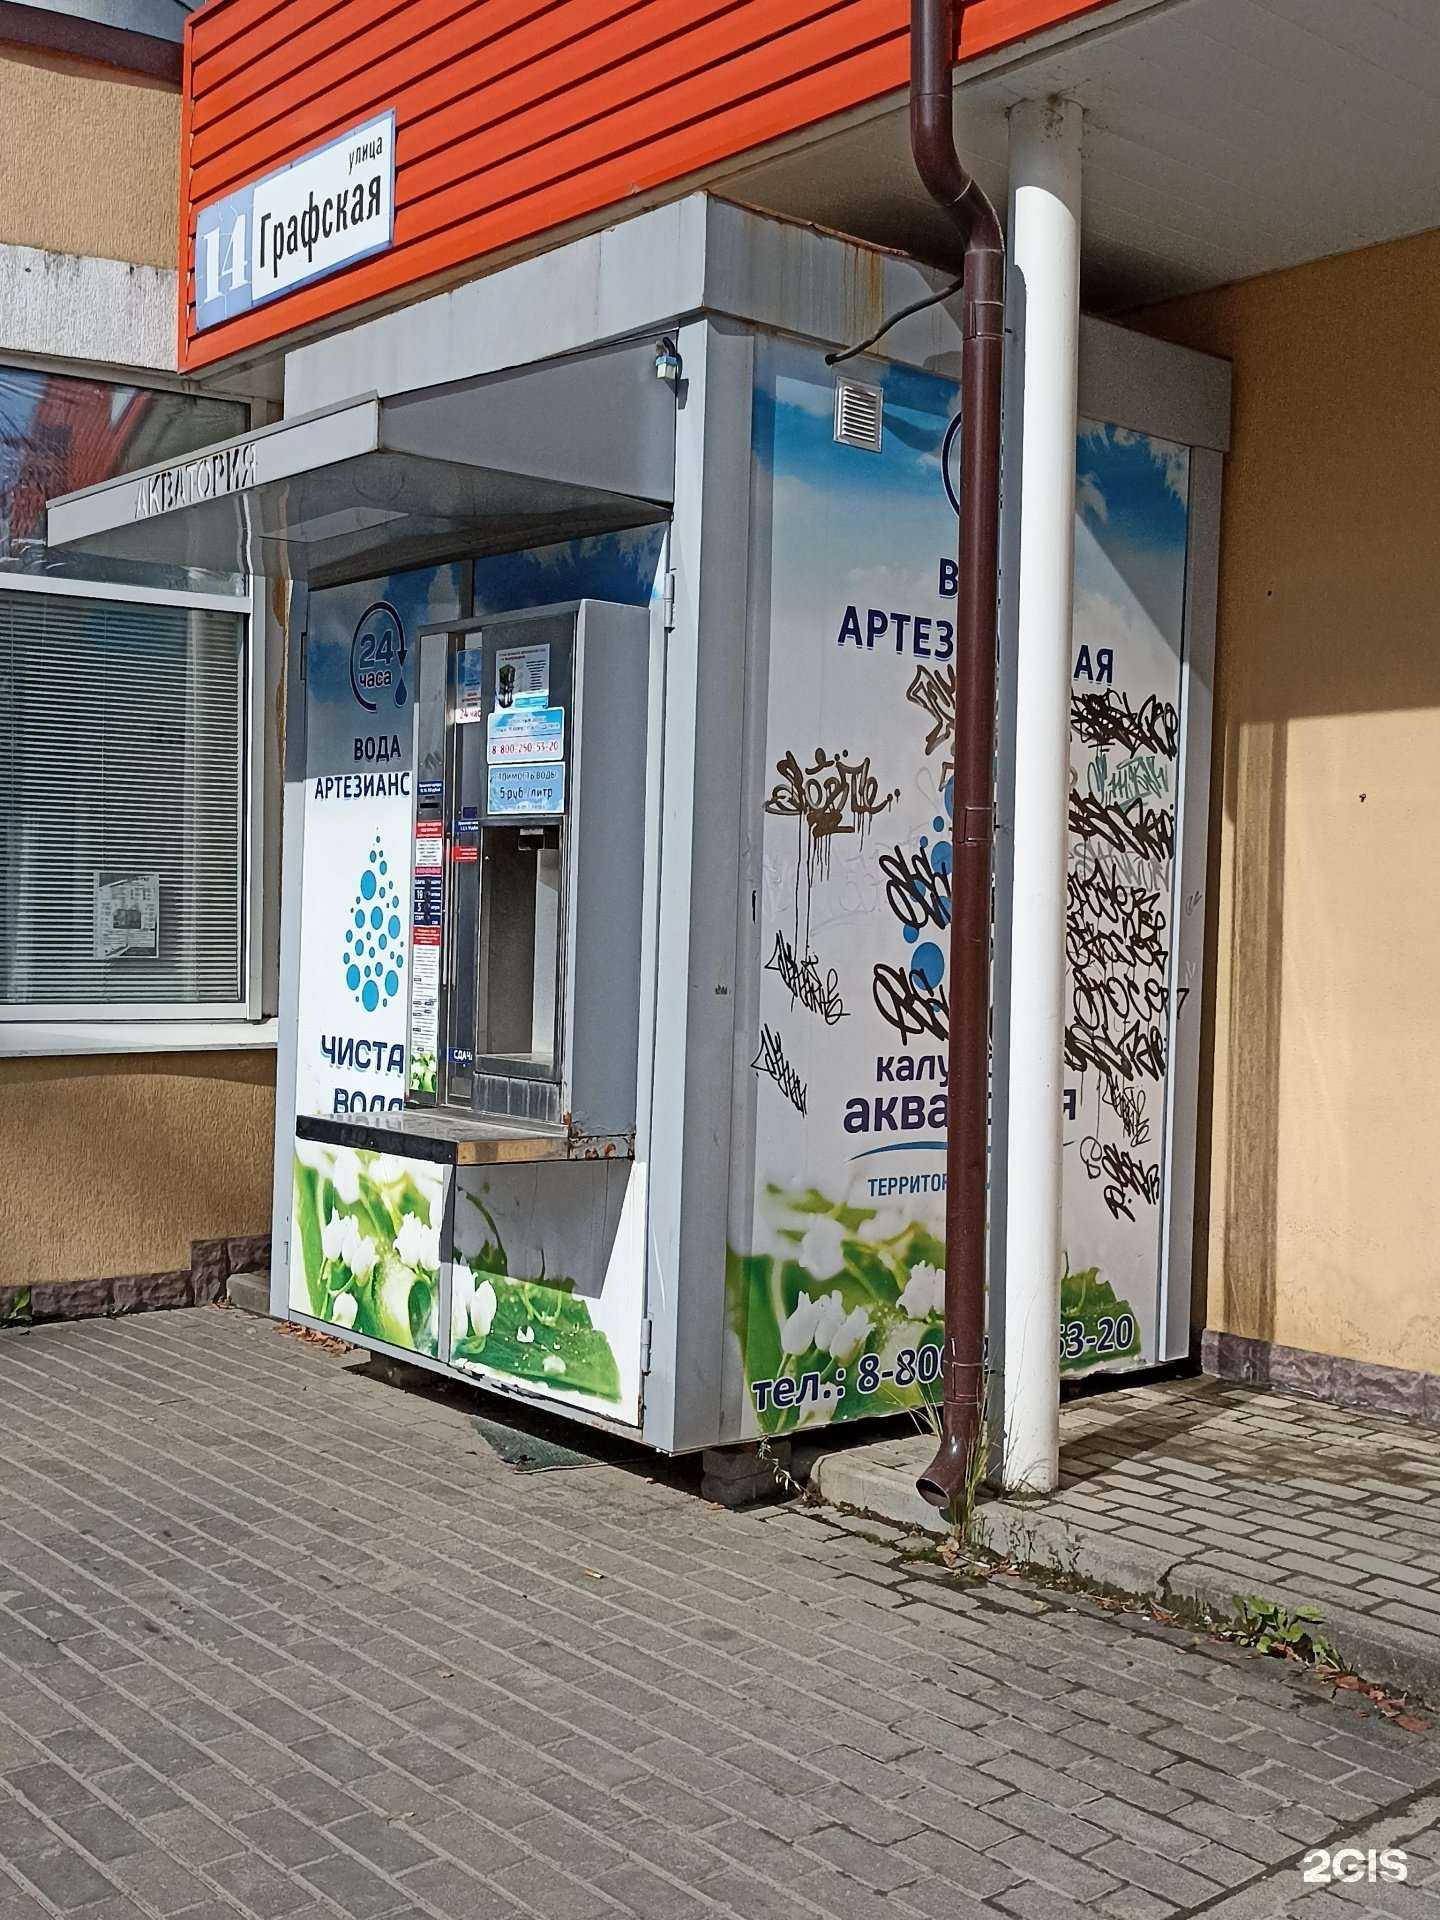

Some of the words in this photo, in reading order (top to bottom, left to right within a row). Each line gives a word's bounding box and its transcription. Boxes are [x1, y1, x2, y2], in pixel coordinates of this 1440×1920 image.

[349, 136, 383, 175] улица
[259, 174, 382, 279] Графская
[203, 213, 249, 304] 14
[135, 443, 258, 519] АКВАТОРИЯ
[359, 629, 395, 669] 24
[359, 670, 393, 689] часа
[354, 734, 402, 763] ВОДА
[314, 771, 411, 801] АРТЕЗИАНС
[321, 1034, 405, 1077] ЧИСТА
[868, 1173, 948, 1198] ТЕРРИТО
[751, 1366, 847, 1413] тел.:
